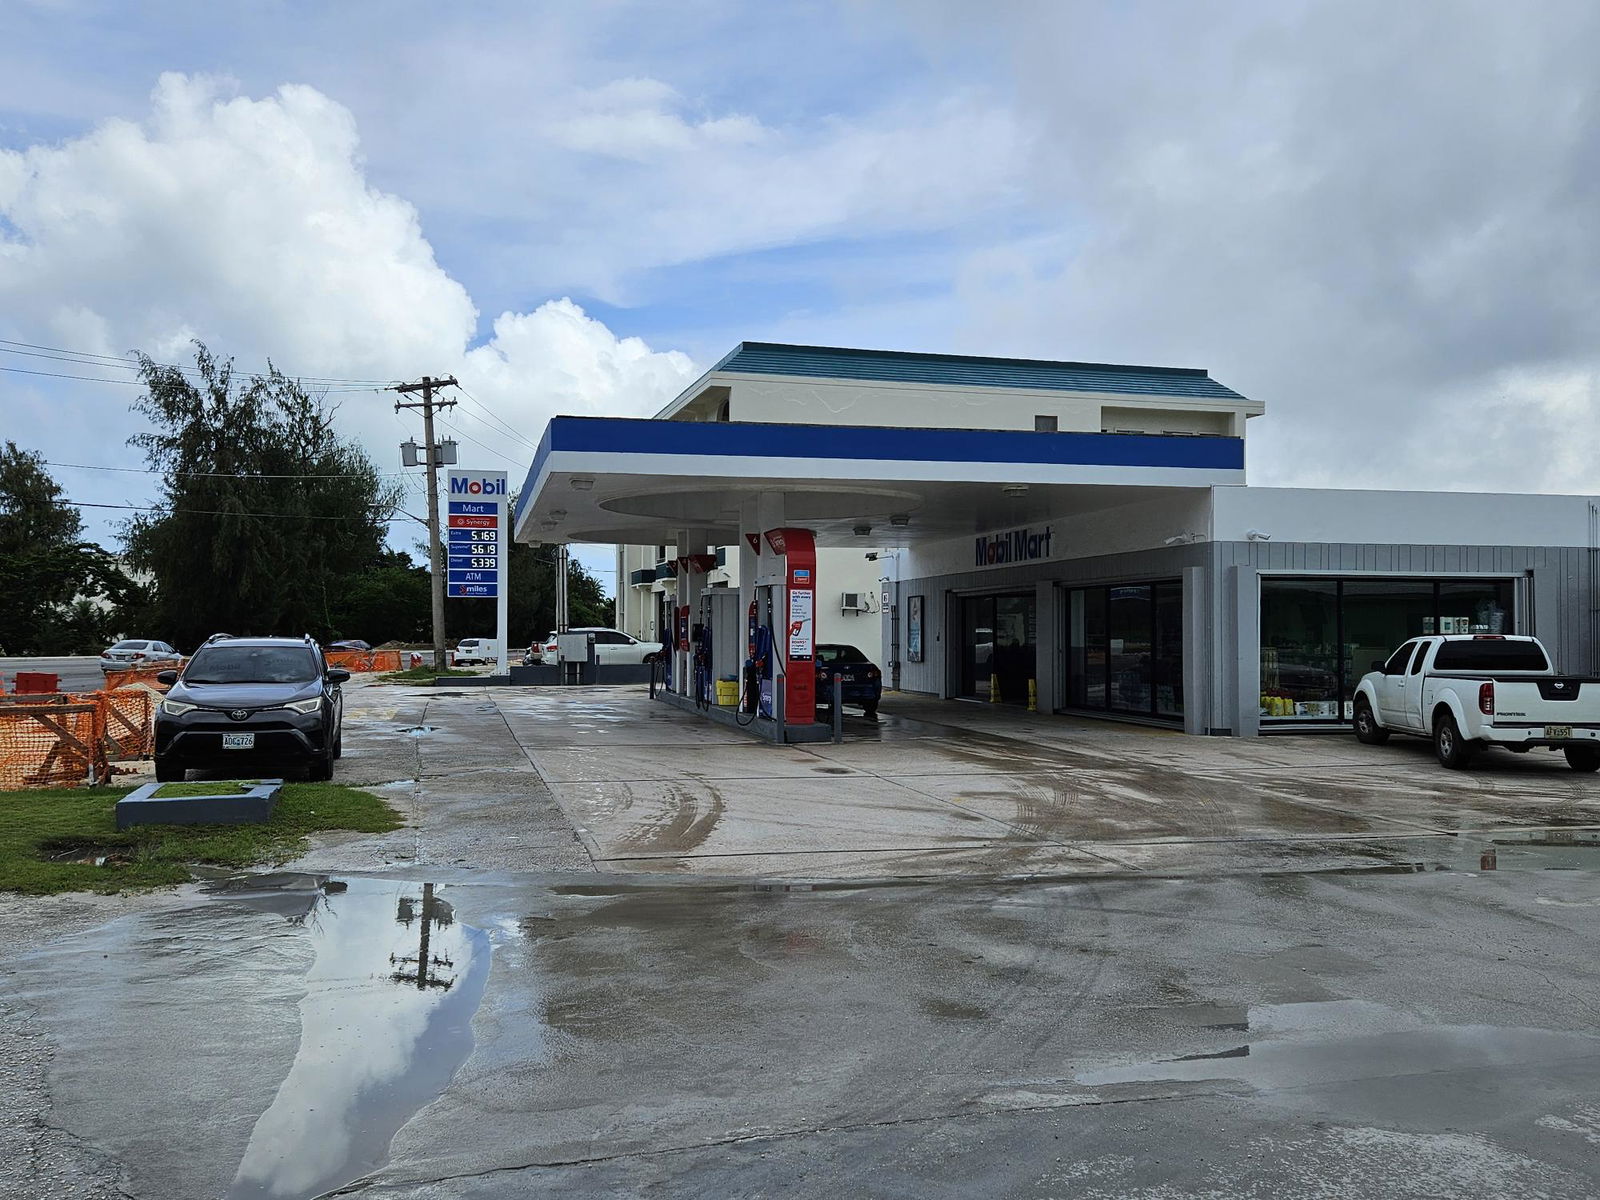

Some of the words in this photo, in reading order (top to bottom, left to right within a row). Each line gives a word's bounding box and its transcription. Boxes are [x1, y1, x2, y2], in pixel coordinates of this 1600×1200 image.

[451, 477, 505, 495] Mobil
[462, 504, 485, 513] Mart
[466, 518, 490, 527] Synergy
[752, 536, 758, 544] 6
[975, 532, 1012, 566] Mobil
[1014, 526, 1052, 561] Mart
[465, 572, 482, 581] ATM
[240, 736, 253, 746] 726
